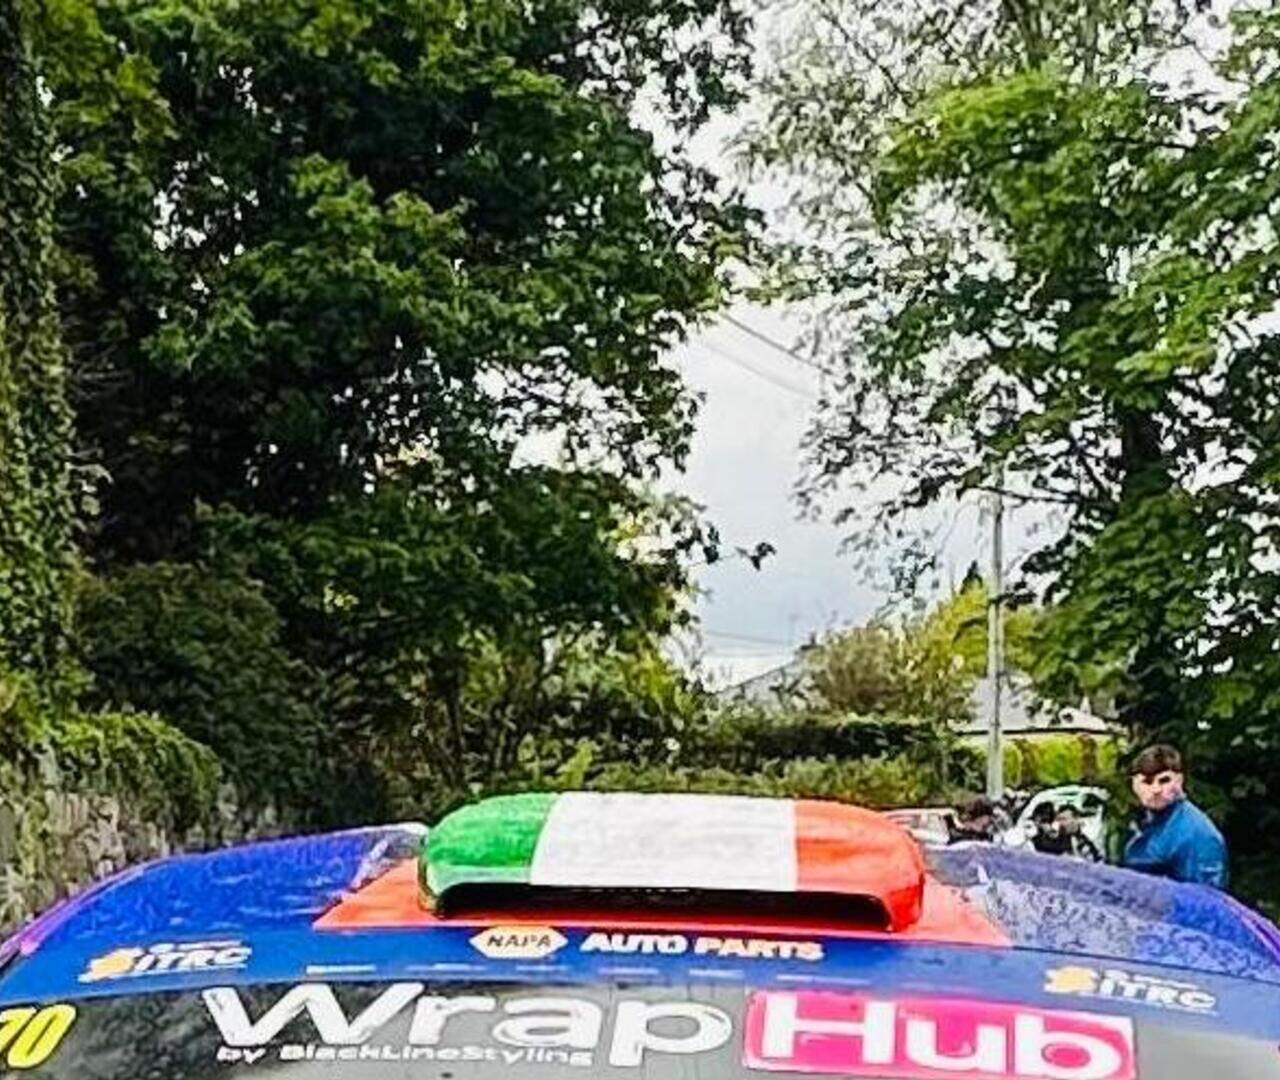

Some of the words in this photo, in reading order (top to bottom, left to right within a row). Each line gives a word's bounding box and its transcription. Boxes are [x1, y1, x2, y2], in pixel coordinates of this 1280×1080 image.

[580, 932, 688, 954] AUTO
[694, 936, 824, 960] PARTS
[202, 982, 733, 1067] Wrap
[217, 1046, 266, 1063] by
